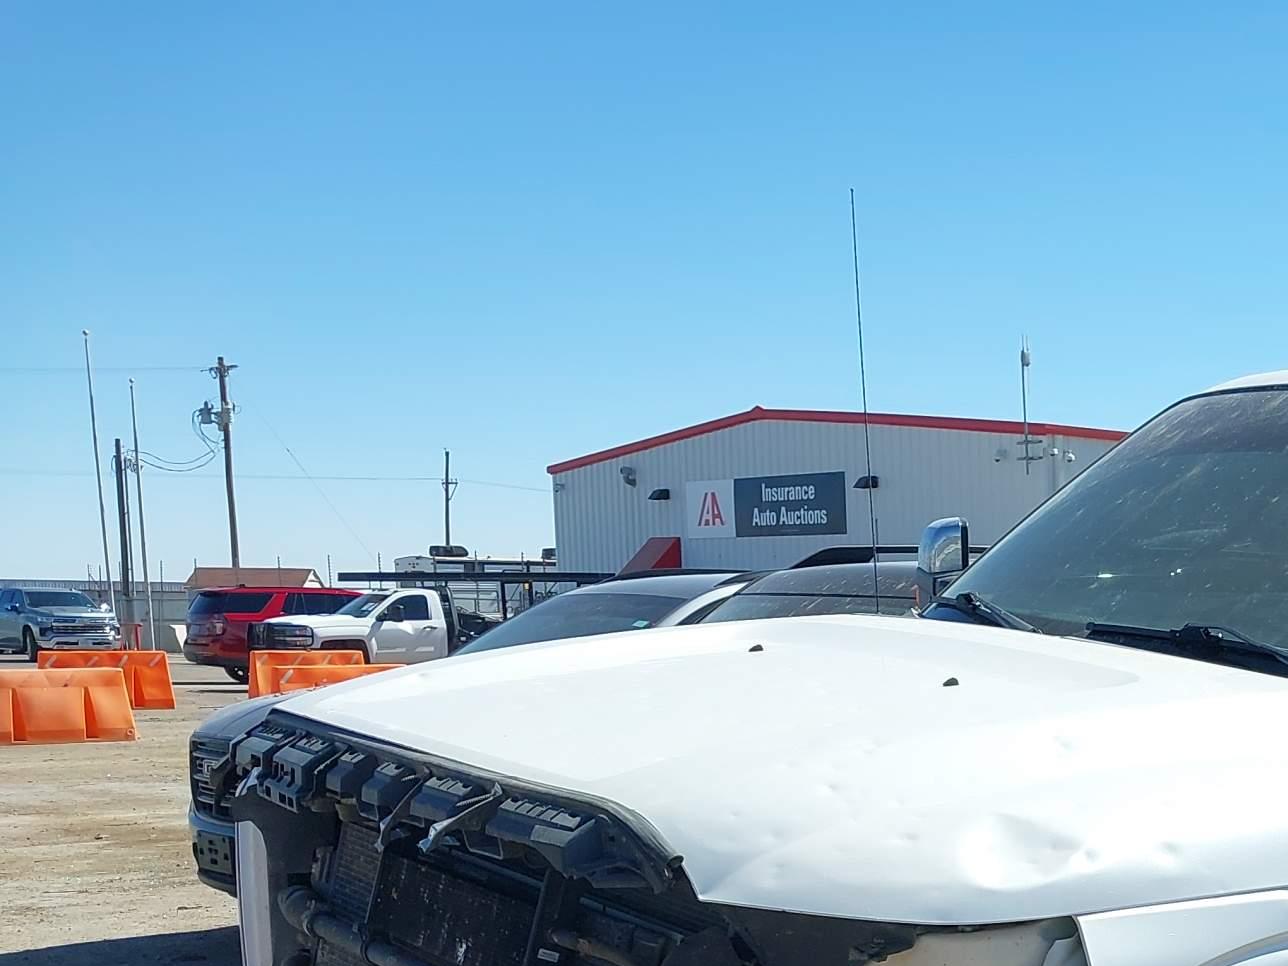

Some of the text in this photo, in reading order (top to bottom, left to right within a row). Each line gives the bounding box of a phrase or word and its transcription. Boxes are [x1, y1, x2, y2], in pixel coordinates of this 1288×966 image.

[761, 482, 816, 502] Insurance
[752, 505, 827, 526] Auto Auctions
